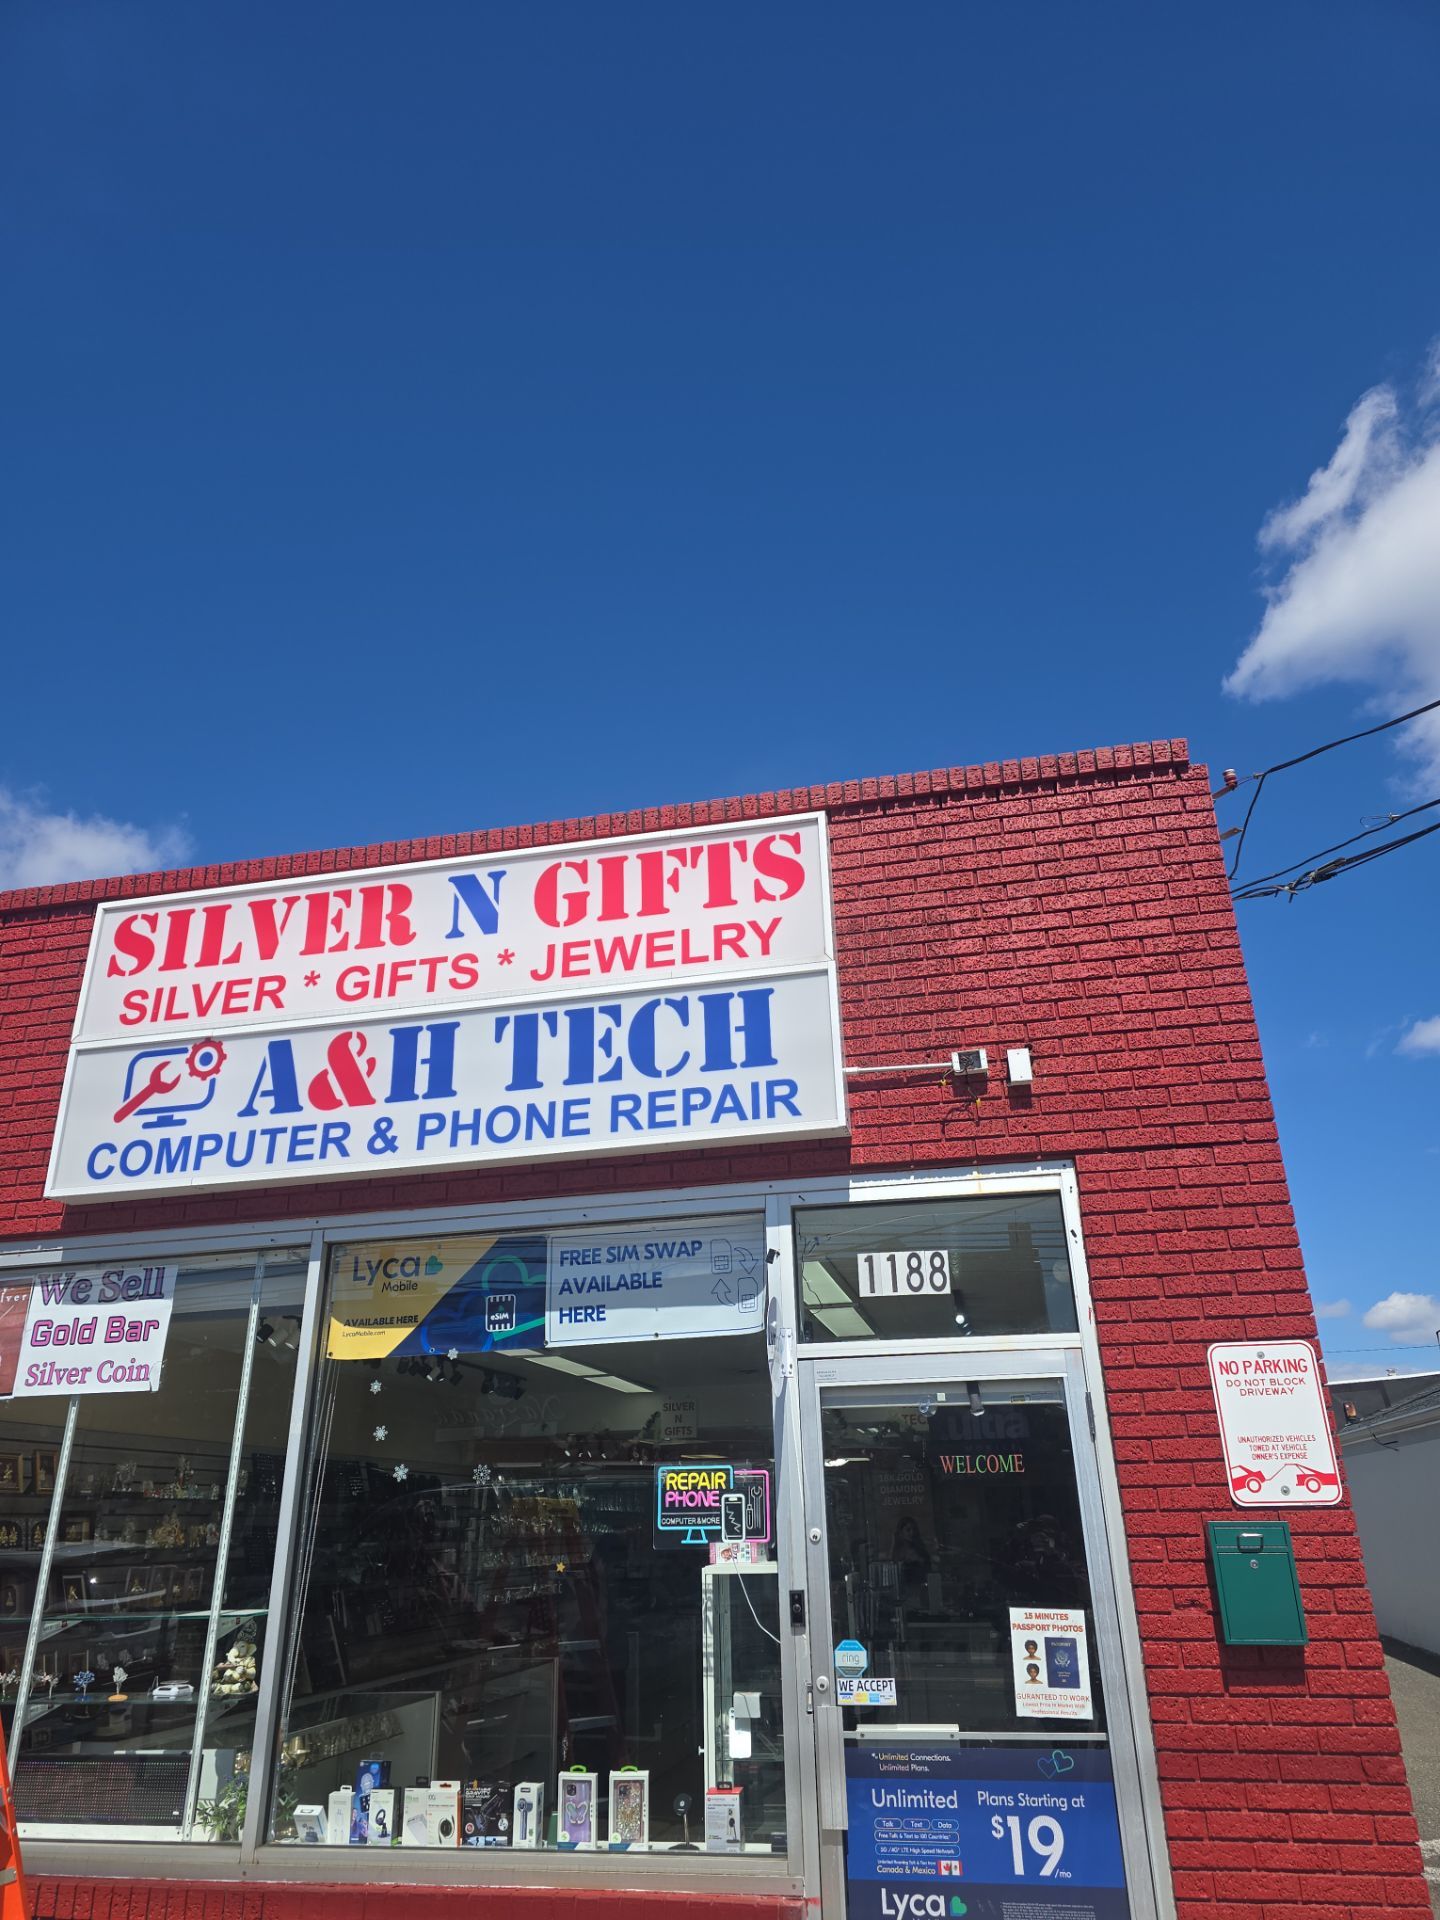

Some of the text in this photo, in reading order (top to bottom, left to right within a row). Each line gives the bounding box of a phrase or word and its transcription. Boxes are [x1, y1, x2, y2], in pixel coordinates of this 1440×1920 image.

[107, 832, 806, 978] SILVER N GIFTS
[118, 974, 287, 1026] SILVER
[335, 953, 480, 1002] GIFTS
[530, 917, 783, 982] JEWELRY
[237, 987, 779, 1117] A&H TECH
[86, 1078, 802, 1181] COMPUTER & PHONE REPAIR
[559, 1240, 703, 1268] FREE SIM SWAP
[352, 1255, 421, 1287] Lyca
[863, 1251, 947, 1294] 1188
[38, 1267, 166, 1306] We Sell
[381, 1280, 418, 1293] Mobile
[558, 1272, 663, 1295] AVAILABLE
[344, 1315, 419, 1326] AVAILABLE HERE
[490, 1311, 509, 1322] eSIM
[559, 1304, 607, 1325] HERE
[30, 1315, 160, 1347] Gold Bar
[24, 1358, 151, 1387] Silver Coin
[1218, 1358, 1308, 1376] NO PARKING
[1225, 1377, 1306, 1387] DO NOT BLOCK
[1240, 1387, 1295, 1397] DRIVEWAY
[662, 1402, 695, 1413] SILVER
[674, 1415, 683, 1424] N
[664, 1426, 693, 1436] GIFTS
[1237, 1434, 1316, 1443] UNAUTHORIZED VEHICLES
[1280, 1452, 1308, 1460] EXPENSE
[1281, 1443, 1308, 1451] VEHICLE
[940, 1454, 1025, 1474] WELCOME
[666, 1472, 727, 1491] REPAIR
[665, 1490, 720, 1508] PHONE
[1035, 1612, 1069, 1620] MINUTES
[1012, 1623, 1084, 1632] PASSPORT PHOTOS
[839, 1680, 893, 1692] WE ACCEPT
[878, 1753, 951, 1762] Unlimited Connections.
[879, 1764, 930, 1772] Unlimited Plans.
[871, 1788, 958, 1809] Unlimited
[977, 1790, 1086, 1811] Plans Starting at
[882, 1820, 894, 1828] Talk
[937, 1821, 952, 1829] Data
[876, 1865, 936, 1875] Canada & Mexico
[881, 1888, 946, 1920] Lyca
